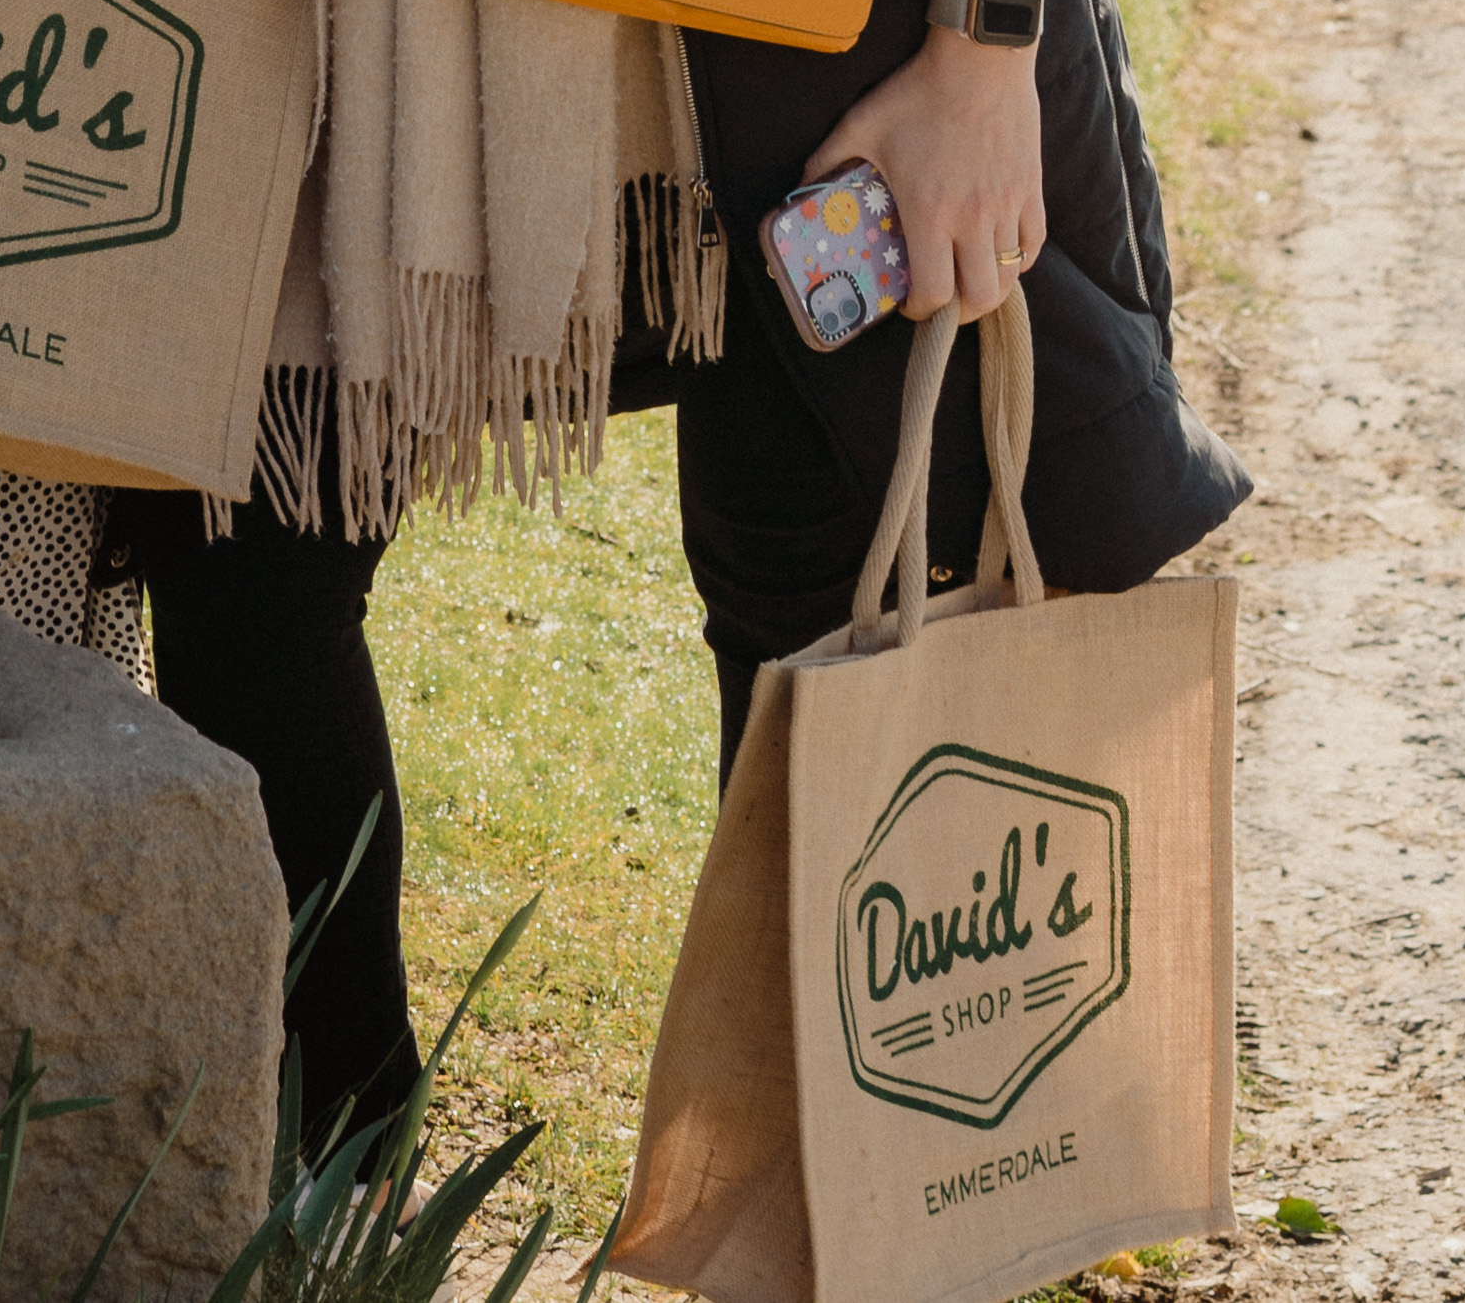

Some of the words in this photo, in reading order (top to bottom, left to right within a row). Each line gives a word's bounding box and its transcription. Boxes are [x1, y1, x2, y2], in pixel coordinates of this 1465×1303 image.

[858, 822, 1093, 1002] David's
[941, 986, 1012, 1037] SHOP
[924, 1131, 1079, 1217] EMMERDALE
